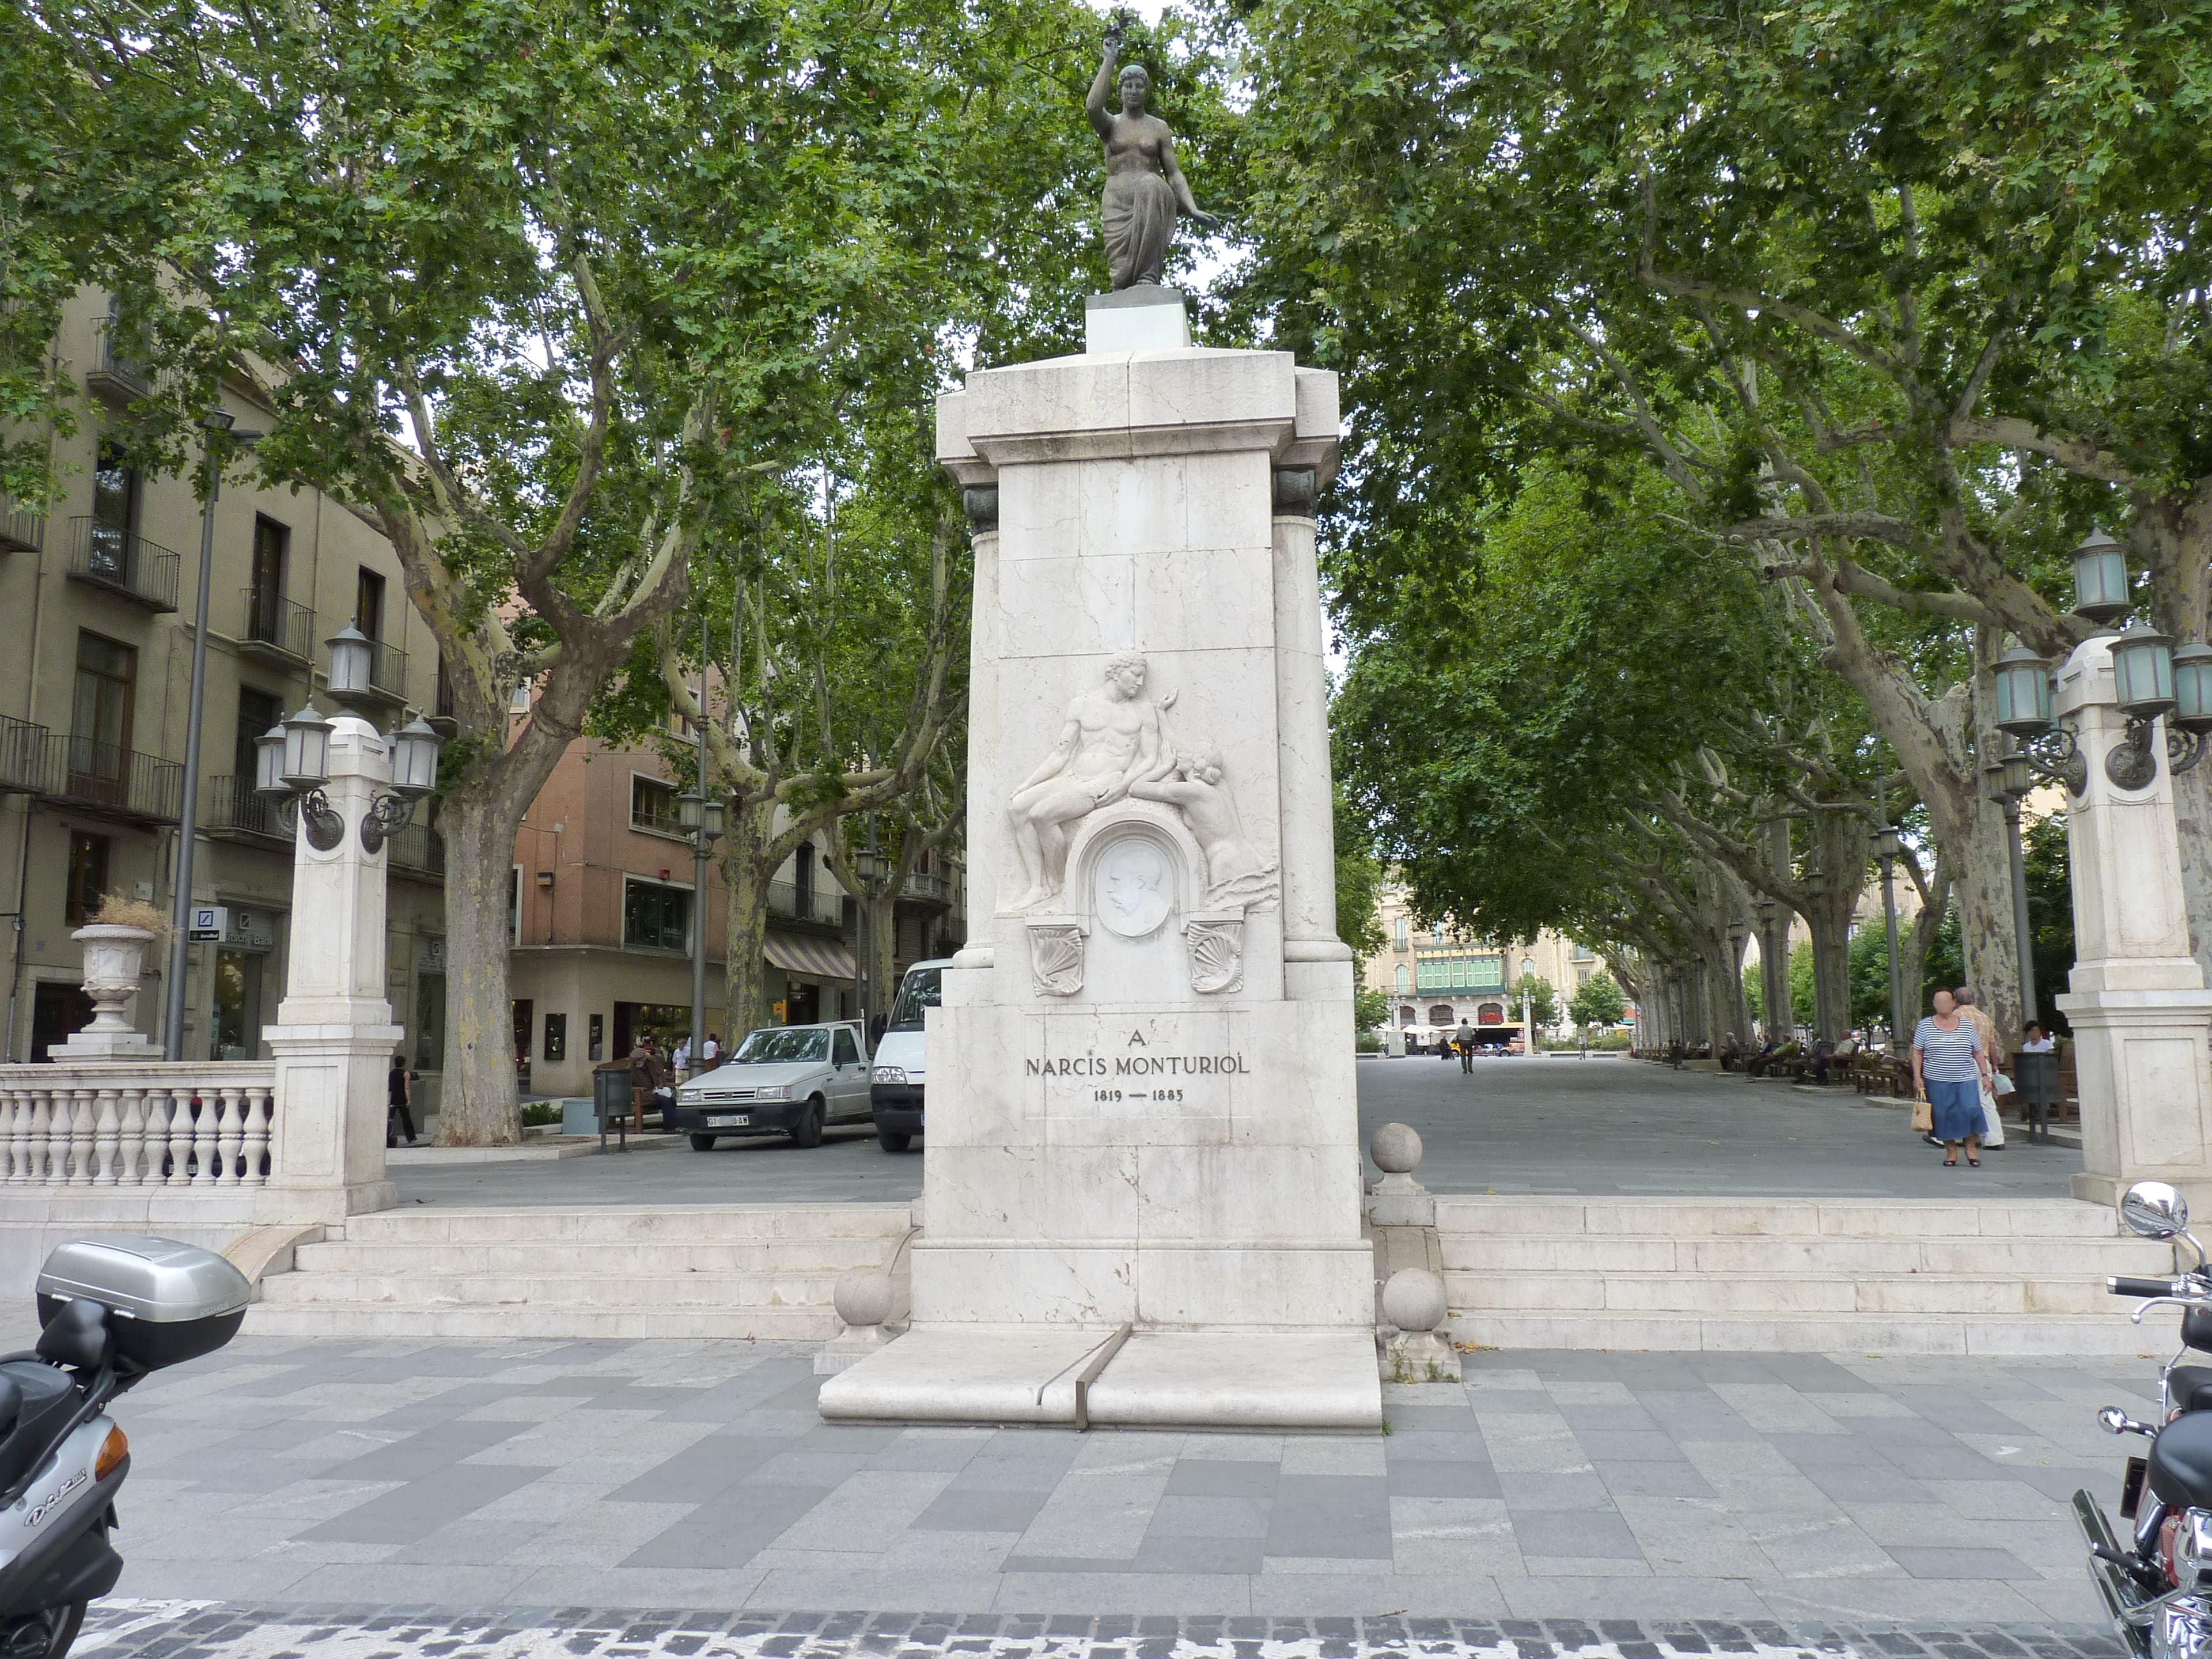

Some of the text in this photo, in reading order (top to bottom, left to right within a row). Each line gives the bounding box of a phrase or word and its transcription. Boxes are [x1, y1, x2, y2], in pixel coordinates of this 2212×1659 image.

[254, 934, 273, 945] Bank
[1127, 1029, 1146, 1046] A
[1094, 1090, 1122, 1102] 1819
[1153, 1089, 1183, 1101] 1885
